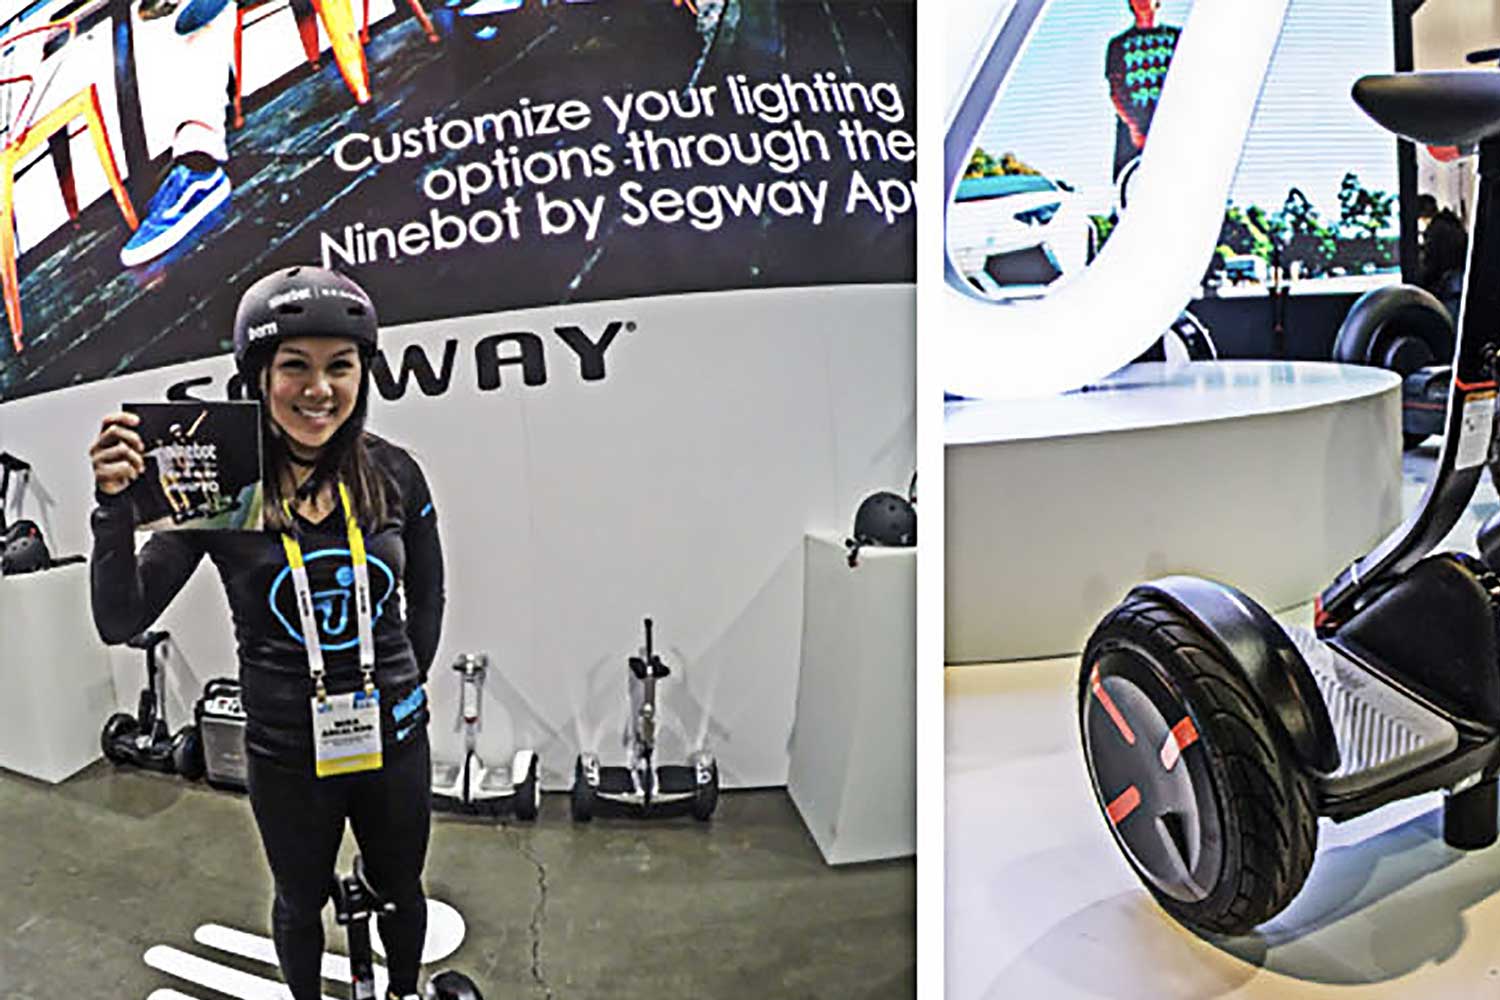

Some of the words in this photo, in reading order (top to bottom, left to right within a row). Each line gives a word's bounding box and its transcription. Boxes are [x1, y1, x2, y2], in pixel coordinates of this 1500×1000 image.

[333, 97, 592, 172] Customize
[603, 86, 717, 134] your
[726, 71, 905, 123] lighting
[423, 145, 616, 206] options
[626, 120, 830, 173] through
[837, 119, 916, 162] the
[319, 196, 522, 271] Ninebot
[535, 191, 606, 242] by
[619, 180, 829, 232] Segway
